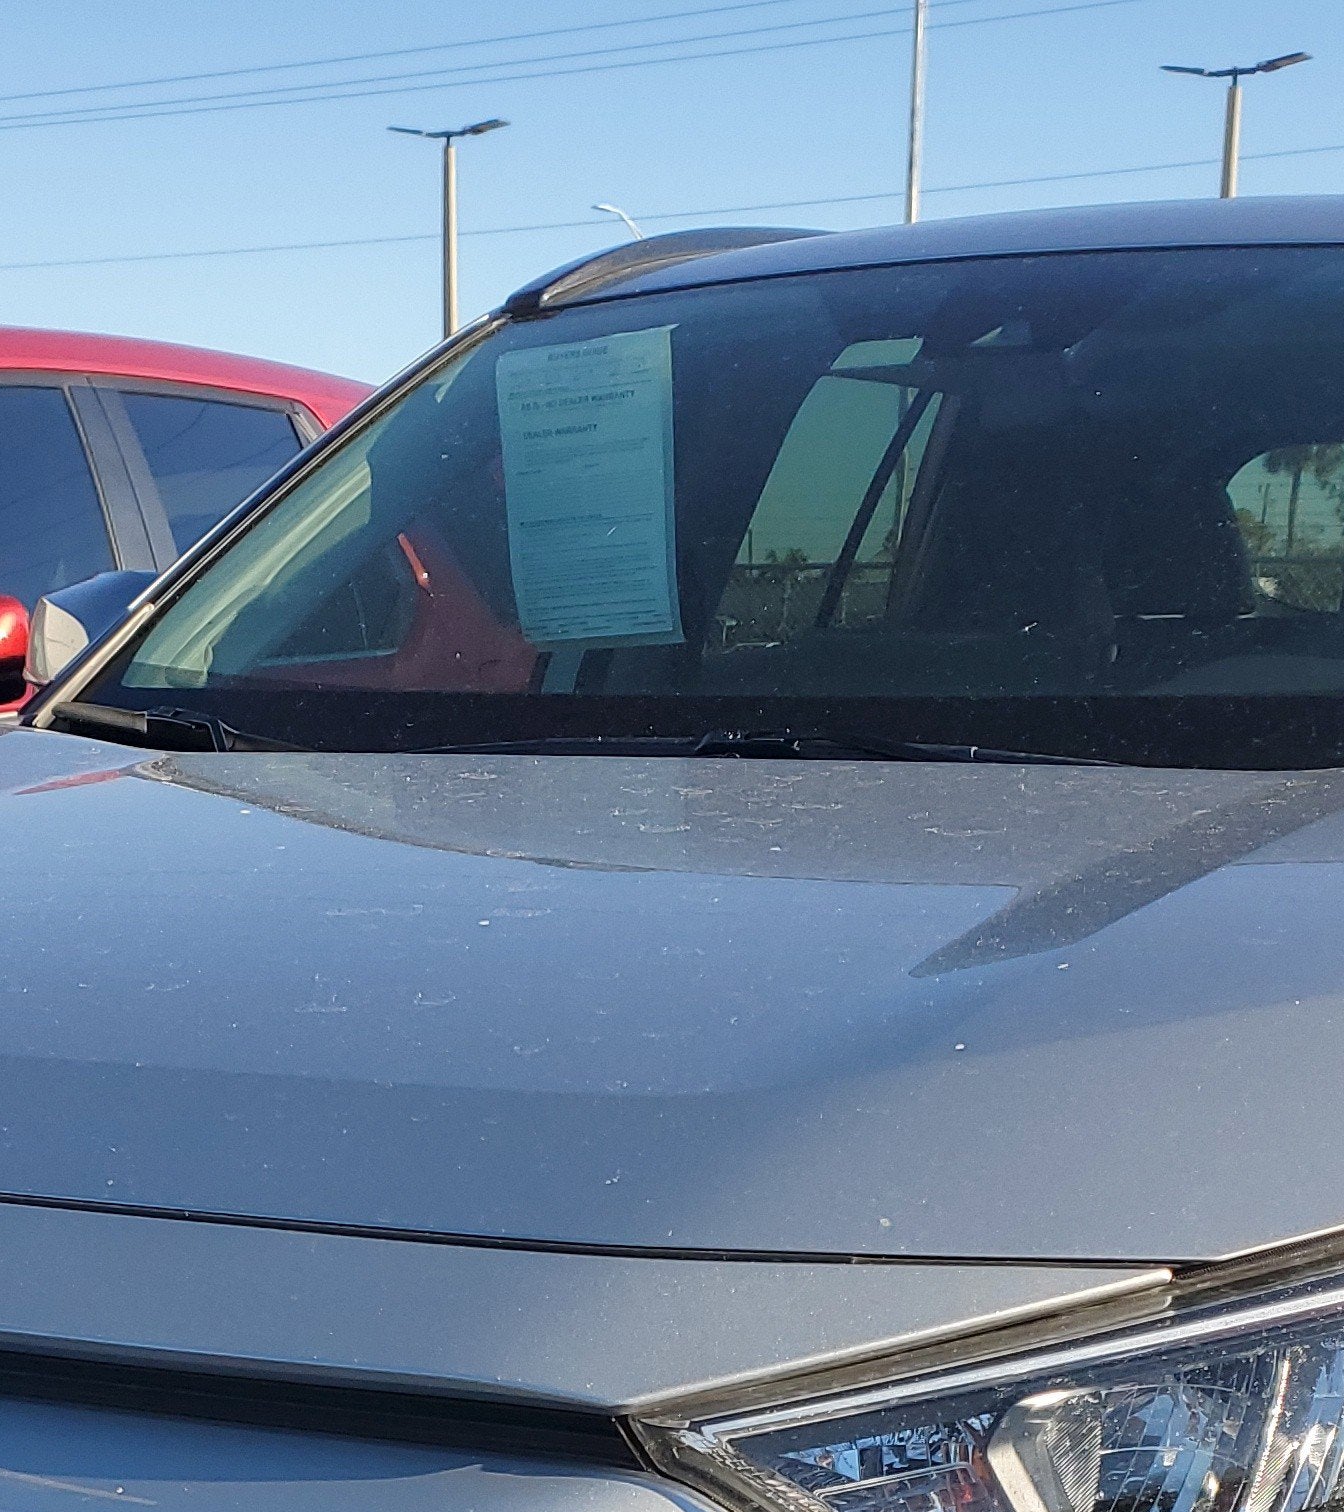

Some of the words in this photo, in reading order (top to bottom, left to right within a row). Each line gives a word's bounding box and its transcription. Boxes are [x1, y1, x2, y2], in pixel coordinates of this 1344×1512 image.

[591, 389, 636, 402] WARRANTY
[522, 428, 553, 440] DEALER
[554, 423, 598, 436] WARRANTY
